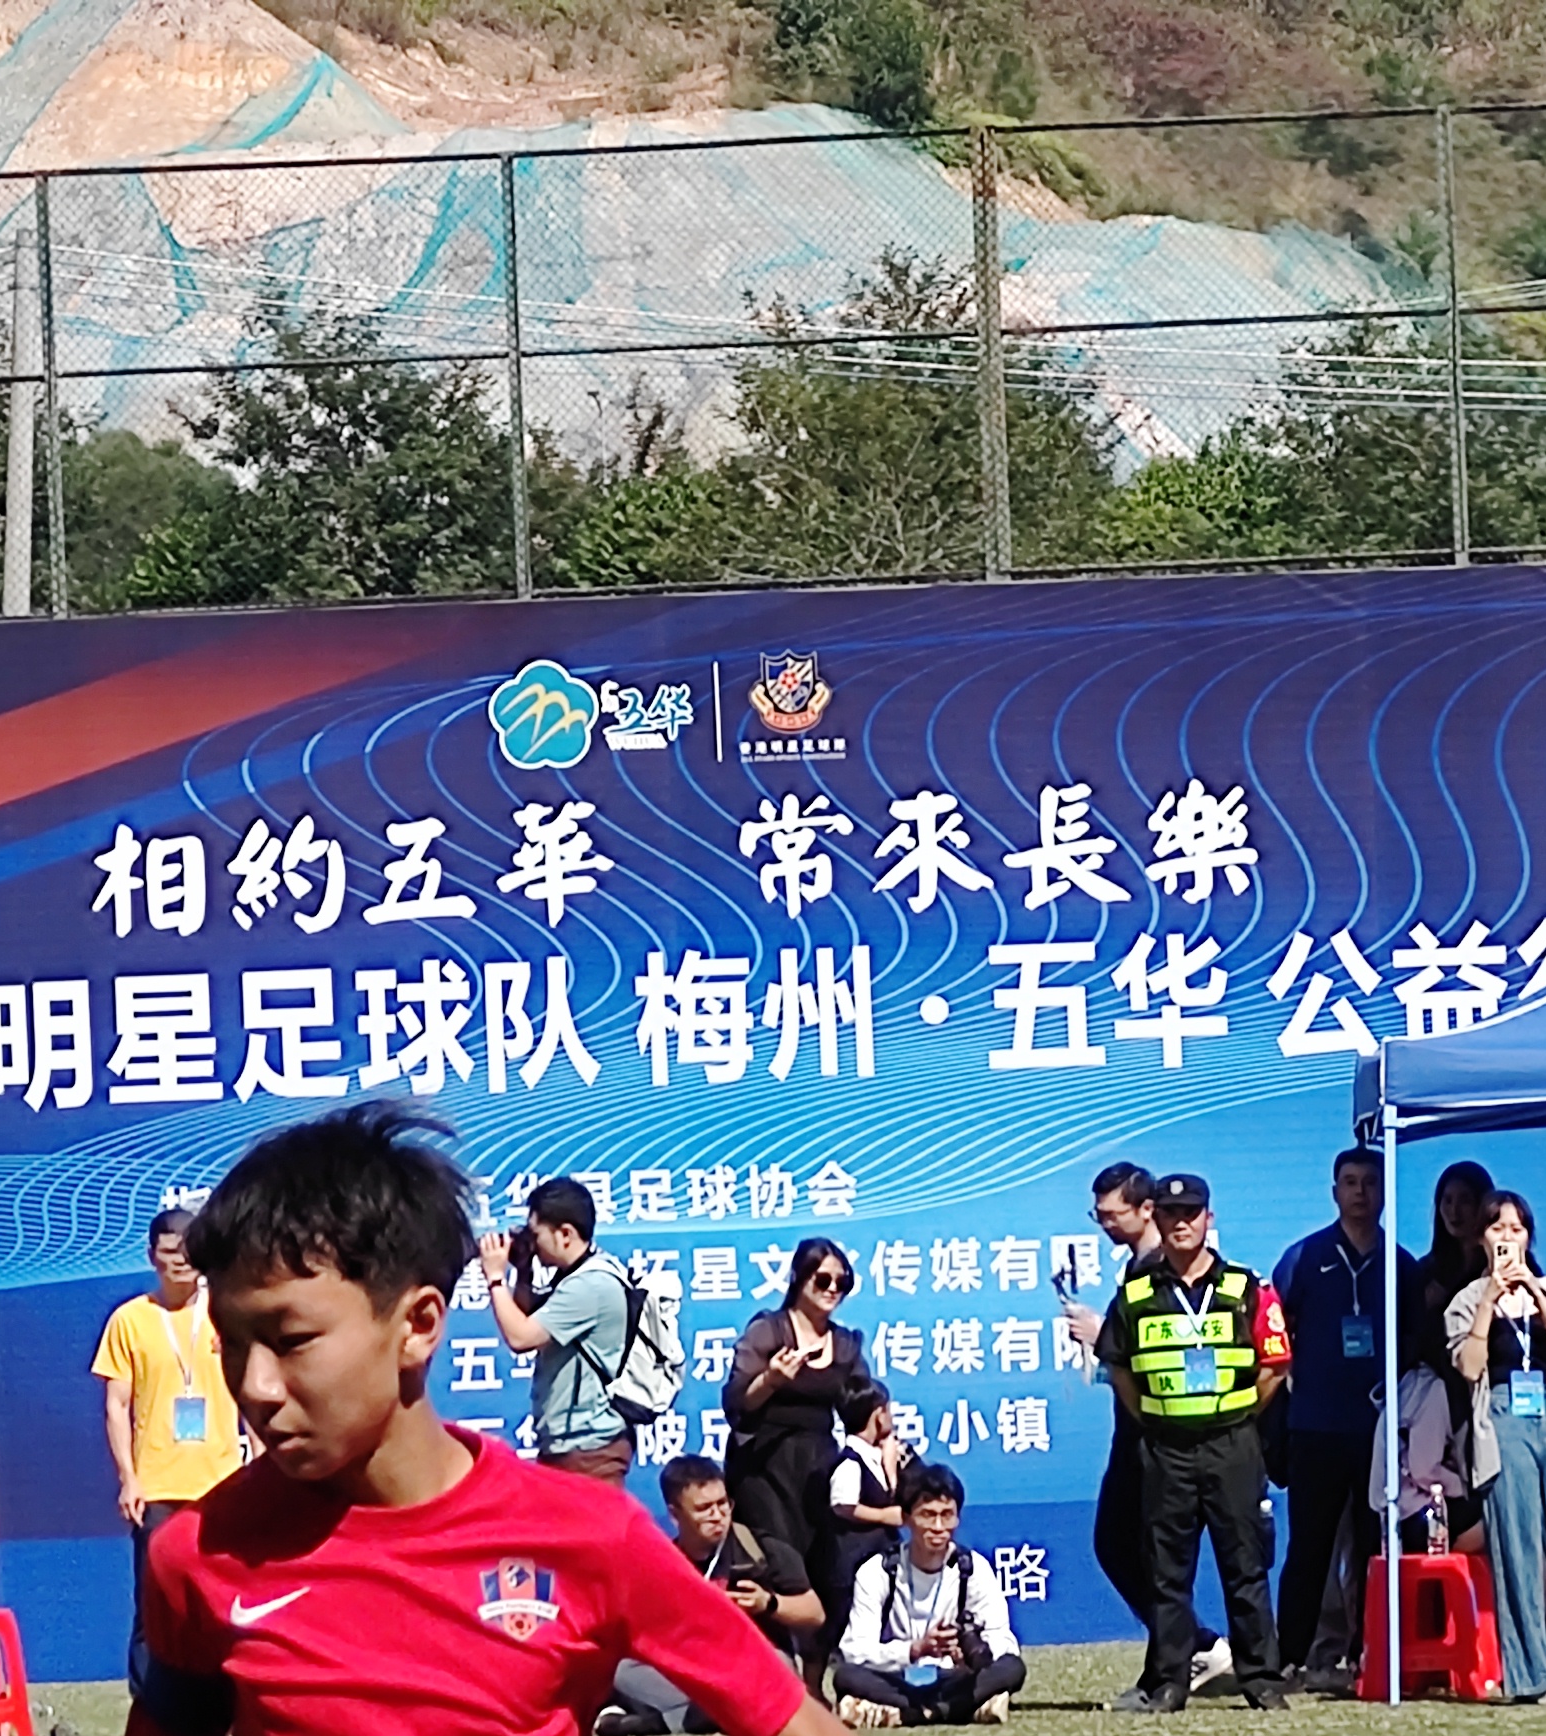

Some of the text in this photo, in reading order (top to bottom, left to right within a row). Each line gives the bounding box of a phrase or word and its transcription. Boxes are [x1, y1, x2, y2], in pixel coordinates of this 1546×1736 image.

[92, 779, 1257, 938] 相約五華 常來長樂
